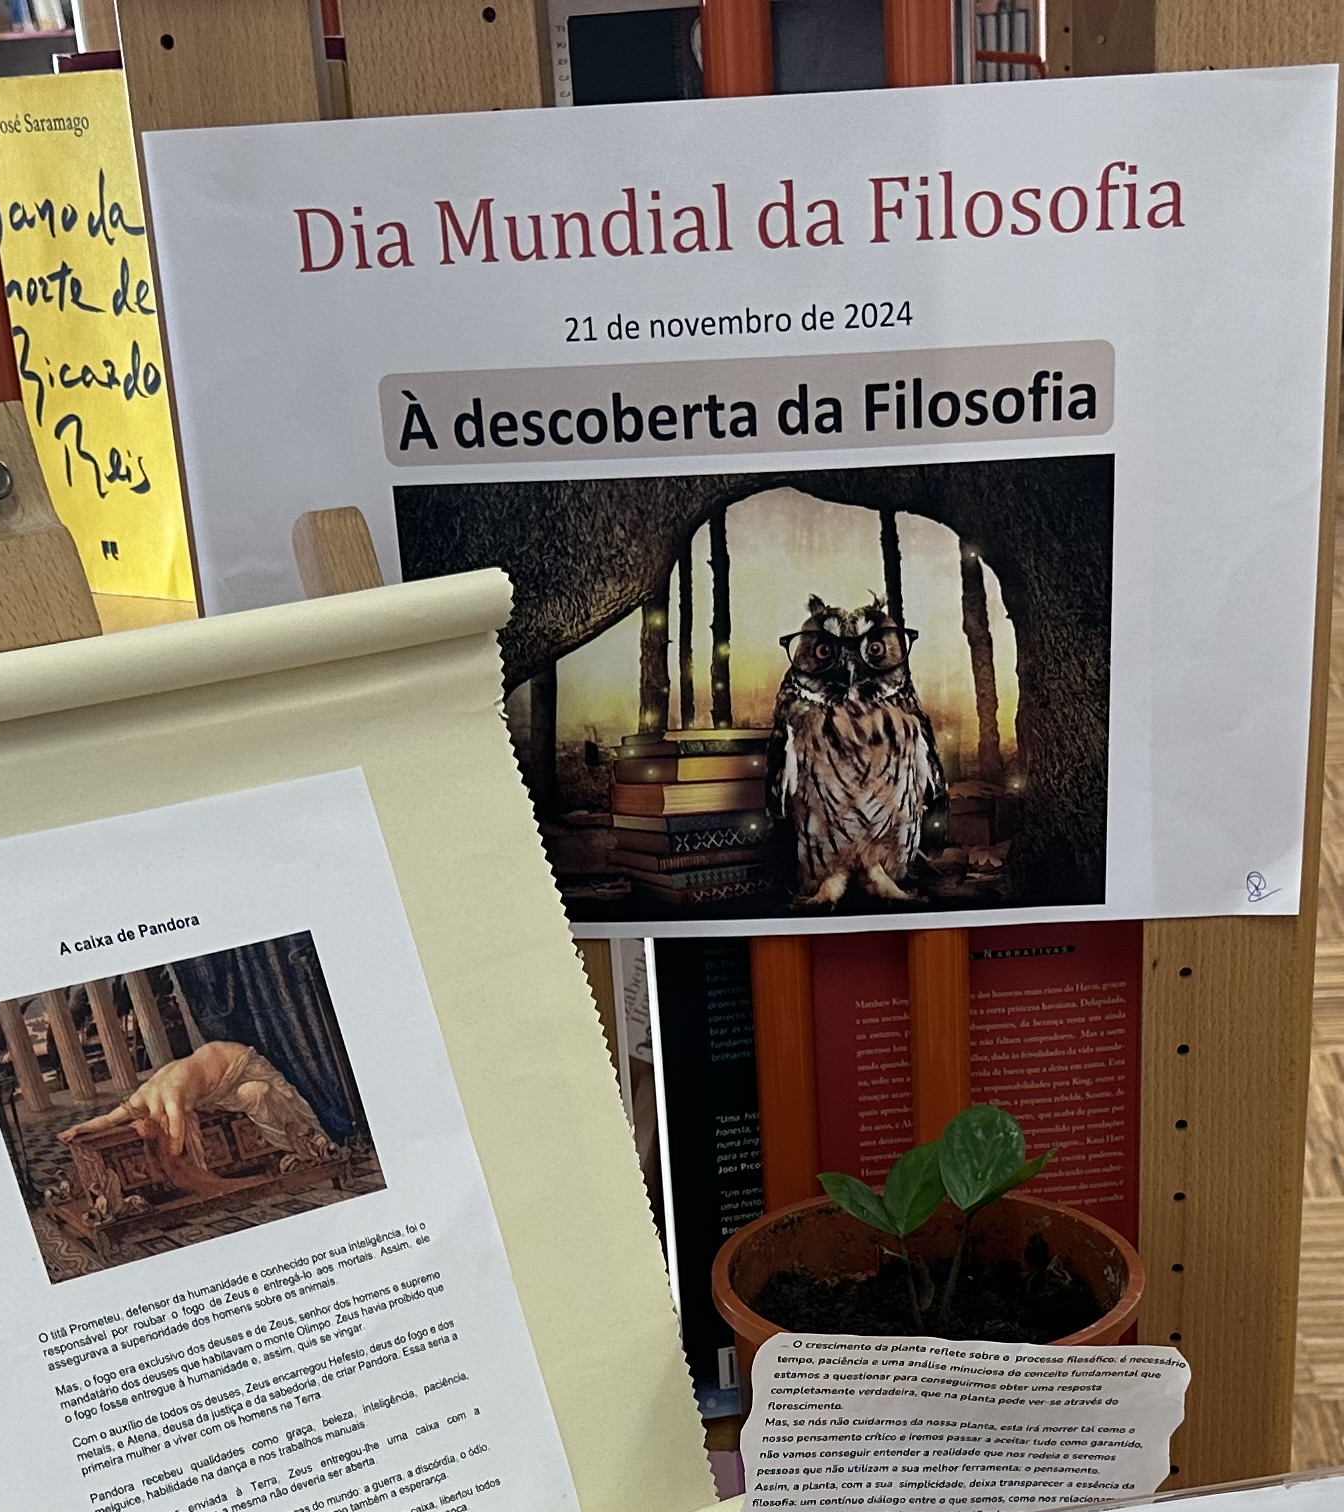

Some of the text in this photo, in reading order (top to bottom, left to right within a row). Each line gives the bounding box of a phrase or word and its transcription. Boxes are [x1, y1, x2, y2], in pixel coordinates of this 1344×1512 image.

[24, 114, 89, 137] Saramago
[295, 162, 1185, 272] Dia Mundial da Filosofia
[112, 257, 156, 315] de
[565, 301, 913, 342] 21 de novembro de 2024
[400, 370, 1096, 451] À descoberta da Filosofia
[55, 413, 152, 498] Reis
[60, 916, 200, 956] A caixa de Pandora
[231, 1494, 268, 1512] mesma
[269, 1488, 288, 1500] não
[290, 1474, 326, 1493] deveria
[328, 1468, 342, 1479] ser
